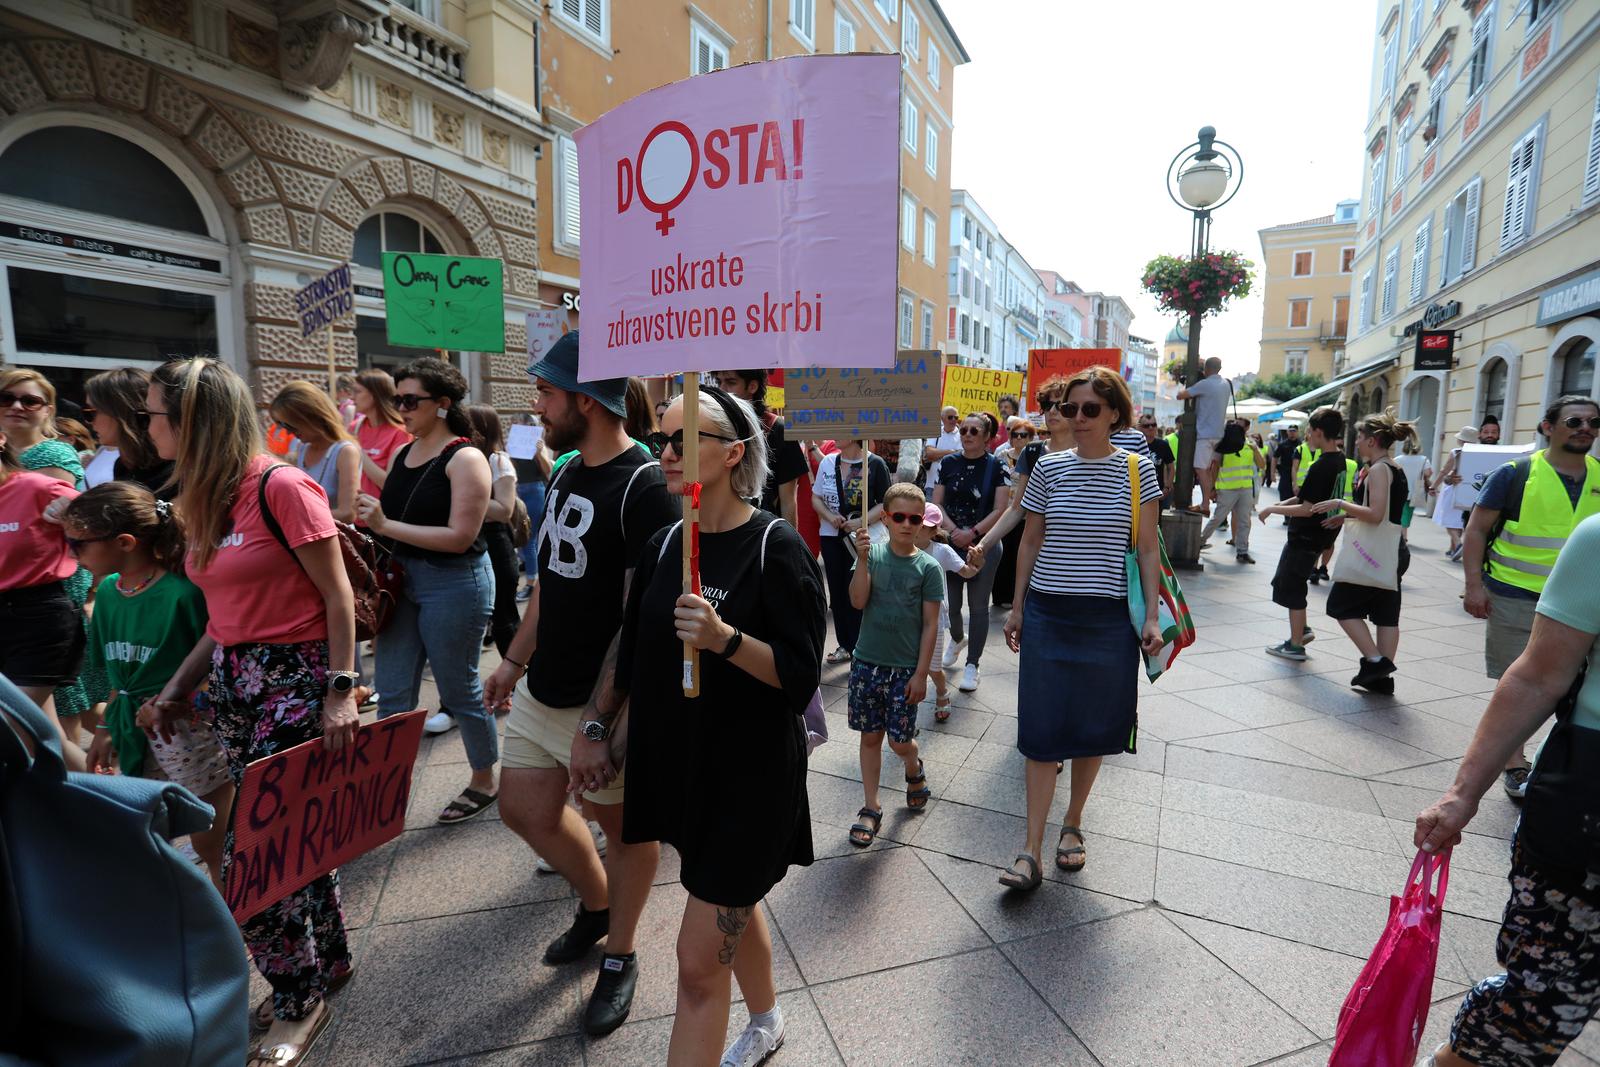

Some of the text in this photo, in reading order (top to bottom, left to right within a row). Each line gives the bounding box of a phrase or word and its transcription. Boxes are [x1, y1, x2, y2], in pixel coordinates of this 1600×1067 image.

[650, 251, 744, 297] uskrate
[607, 290, 821, 349] zdravstvene skrbi
[951, 368, 1009, 389] ODJEBI
[1032, 350, 1056, 370] NE
[857, 409, 879, 424] NO
[250, 719, 407, 831] 8. MART
[297, 764, 409, 877] RADNICA
